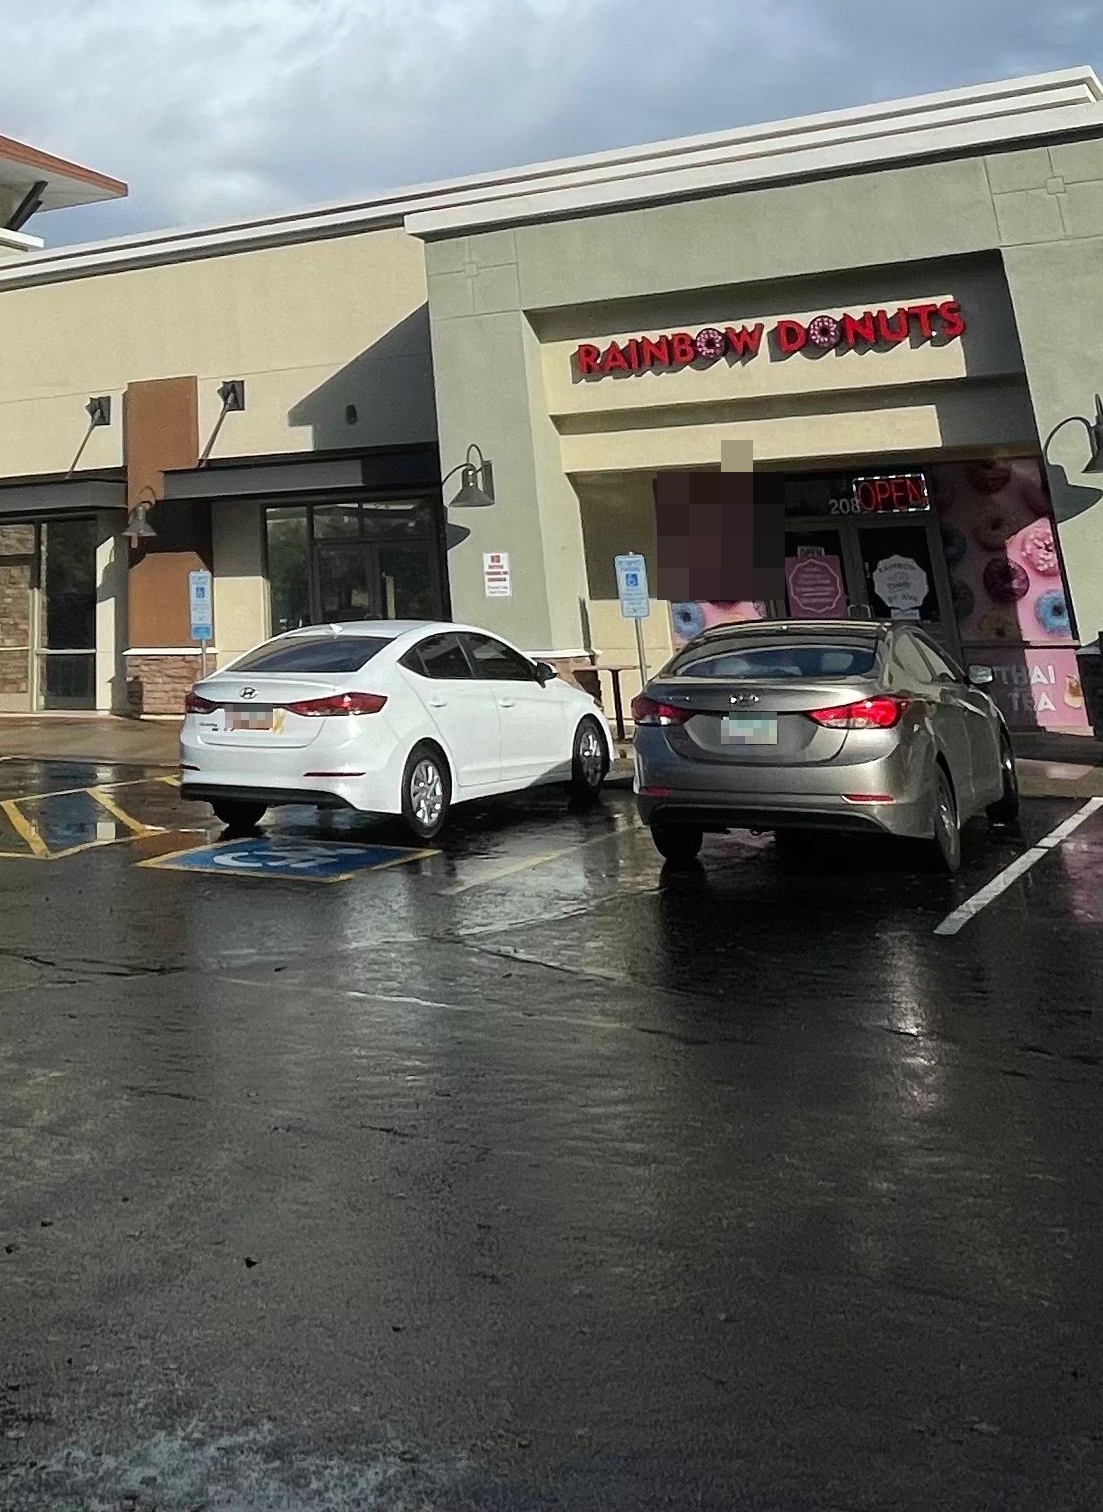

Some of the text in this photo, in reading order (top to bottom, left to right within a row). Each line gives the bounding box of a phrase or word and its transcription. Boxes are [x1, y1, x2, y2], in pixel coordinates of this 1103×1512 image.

[577, 300, 966, 374] RAINBOW DONUTS
[858, 478, 927, 511] OPEN
[828, 497, 860, 514] 208
[993, 664, 1056, 685] THAI
[1008, 691, 1056, 712] TEA
